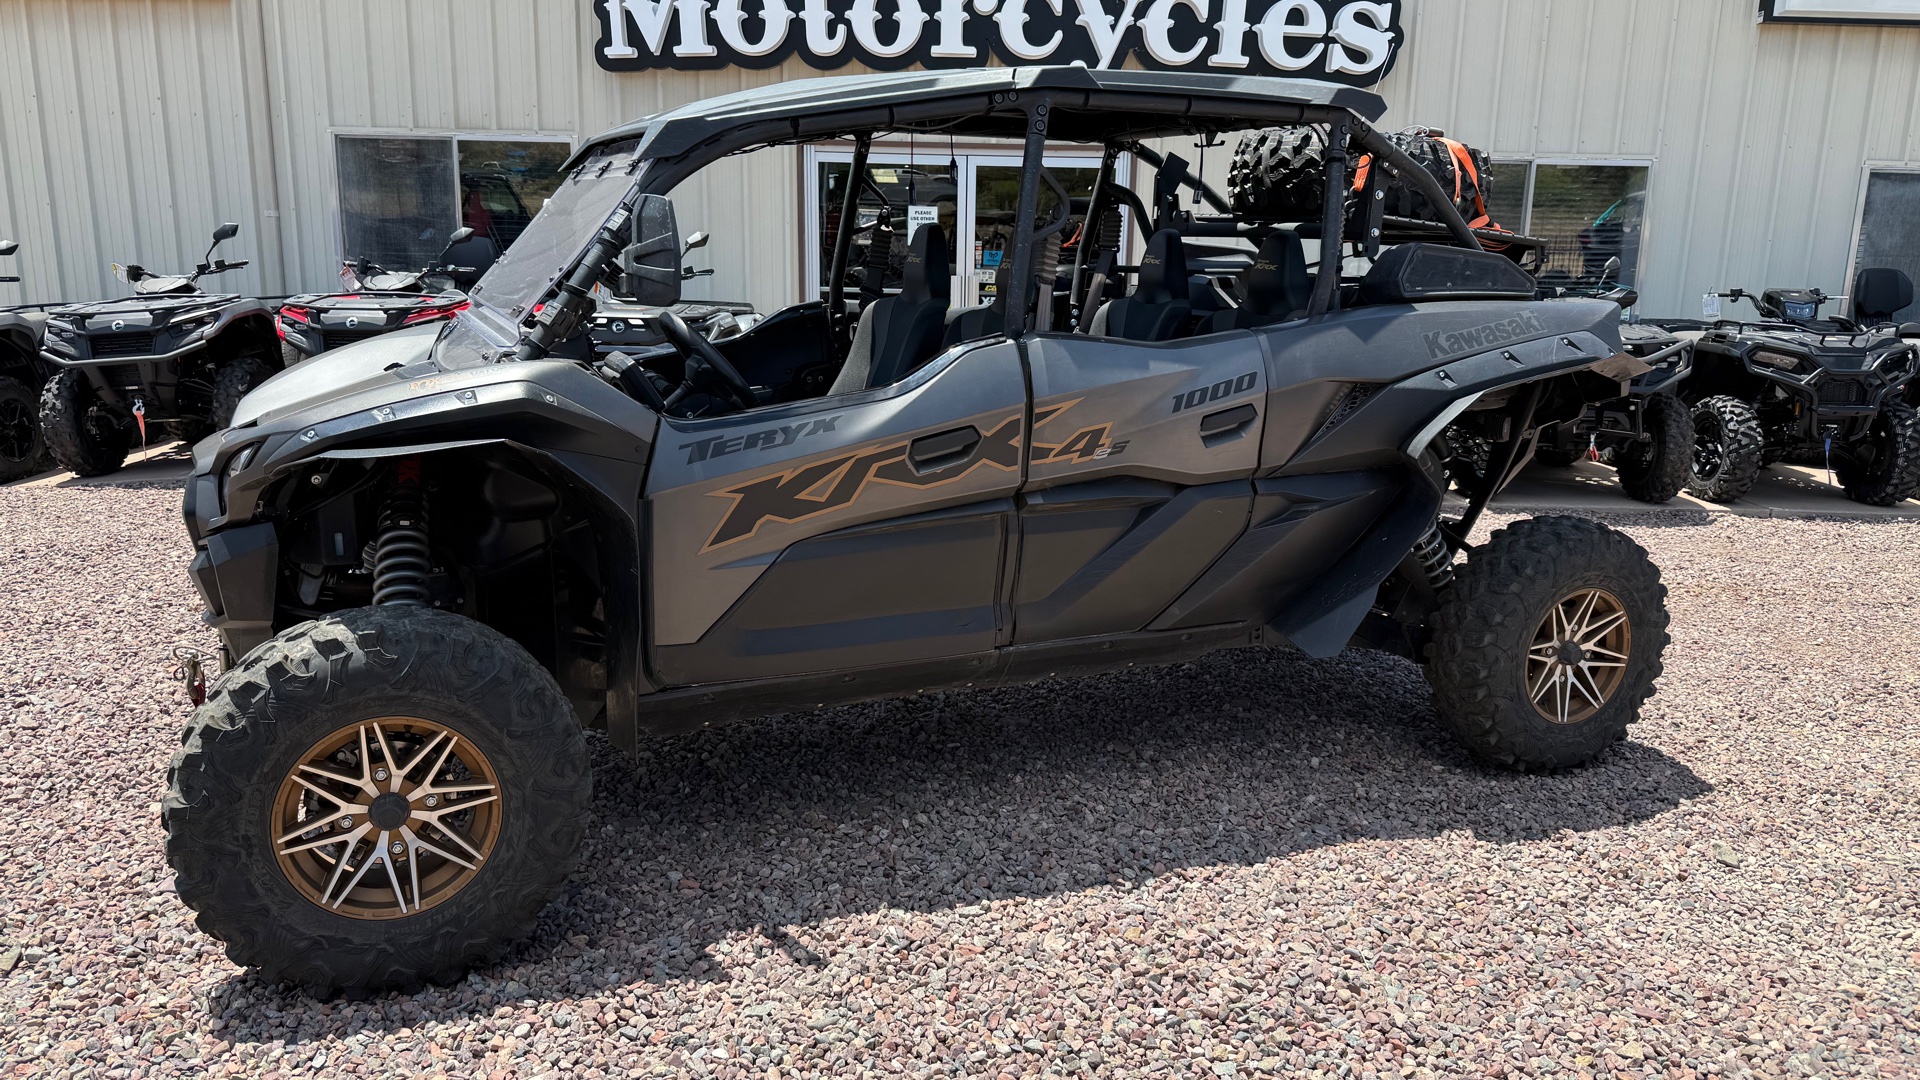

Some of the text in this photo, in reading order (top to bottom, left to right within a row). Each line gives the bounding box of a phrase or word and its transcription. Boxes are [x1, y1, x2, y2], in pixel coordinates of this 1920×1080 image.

[602, 0, 1396, 73] Motorcycles
[1421, 309, 1547, 360] Kawasaki
[1171, 371, 1258, 414] 1000
[679, 415, 844, 465] TERYX
